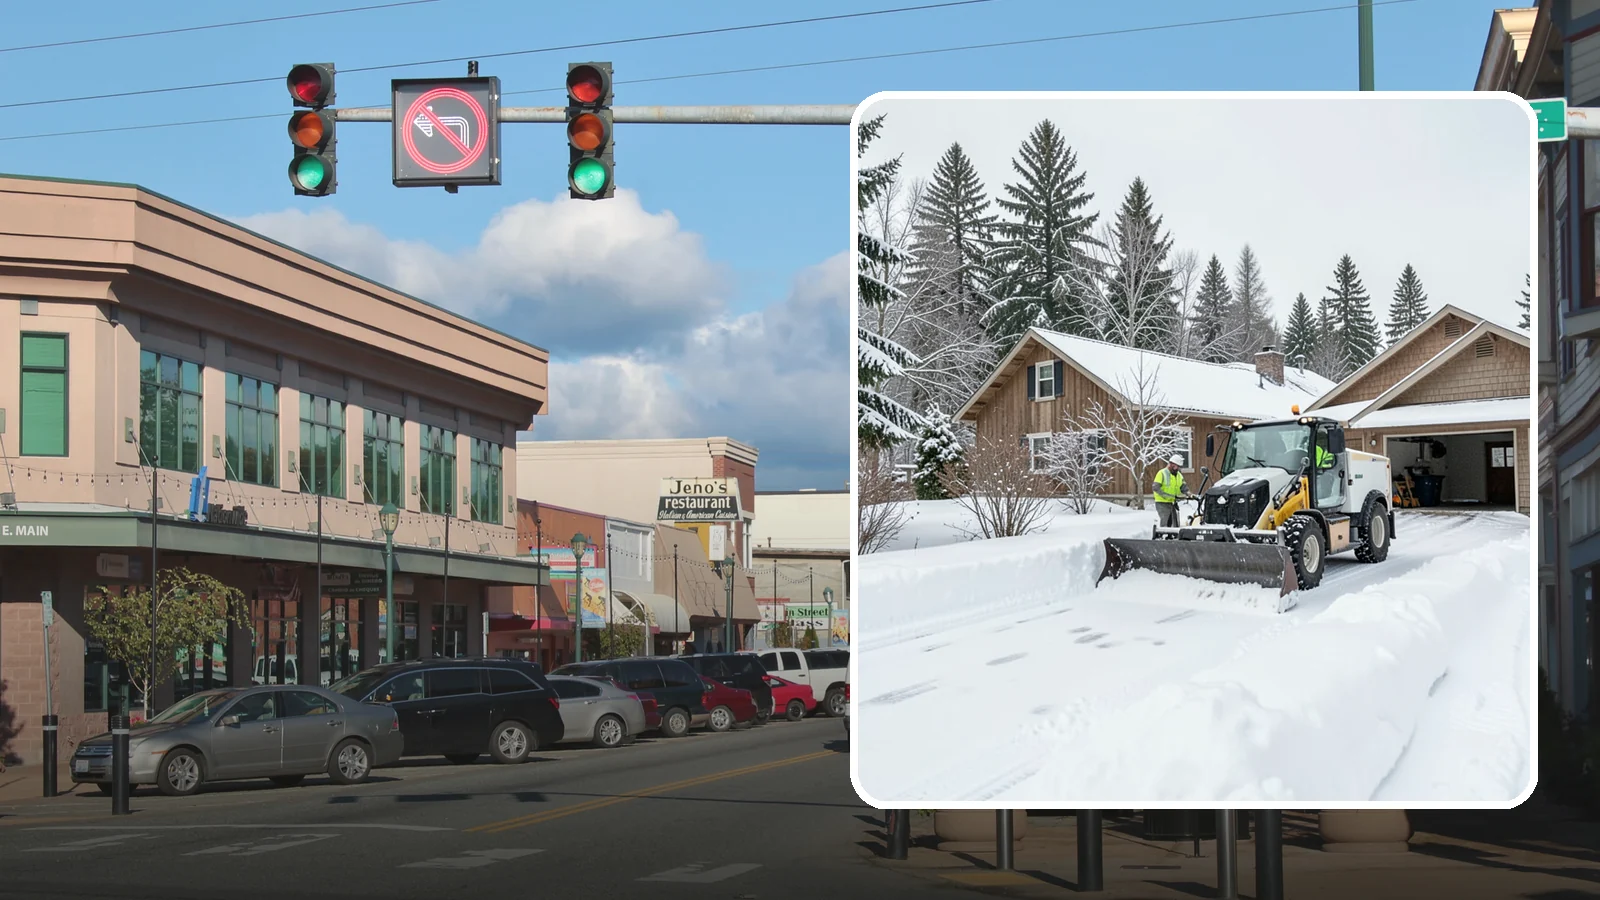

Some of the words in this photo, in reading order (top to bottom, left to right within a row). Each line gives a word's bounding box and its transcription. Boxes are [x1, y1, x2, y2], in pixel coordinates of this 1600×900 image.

[670, 480, 727, 494] Jeno's
[665, 496, 731, 509] restaurant
[658, 510, 681, 519] Italian
[685, 509, 714, 519] American
[715, 509, 737, 519] Cuisine
[2, 525, 13, 536] E.
[15, 525, 49, 536] MAIN
[797, 608, 828, 617] Street
